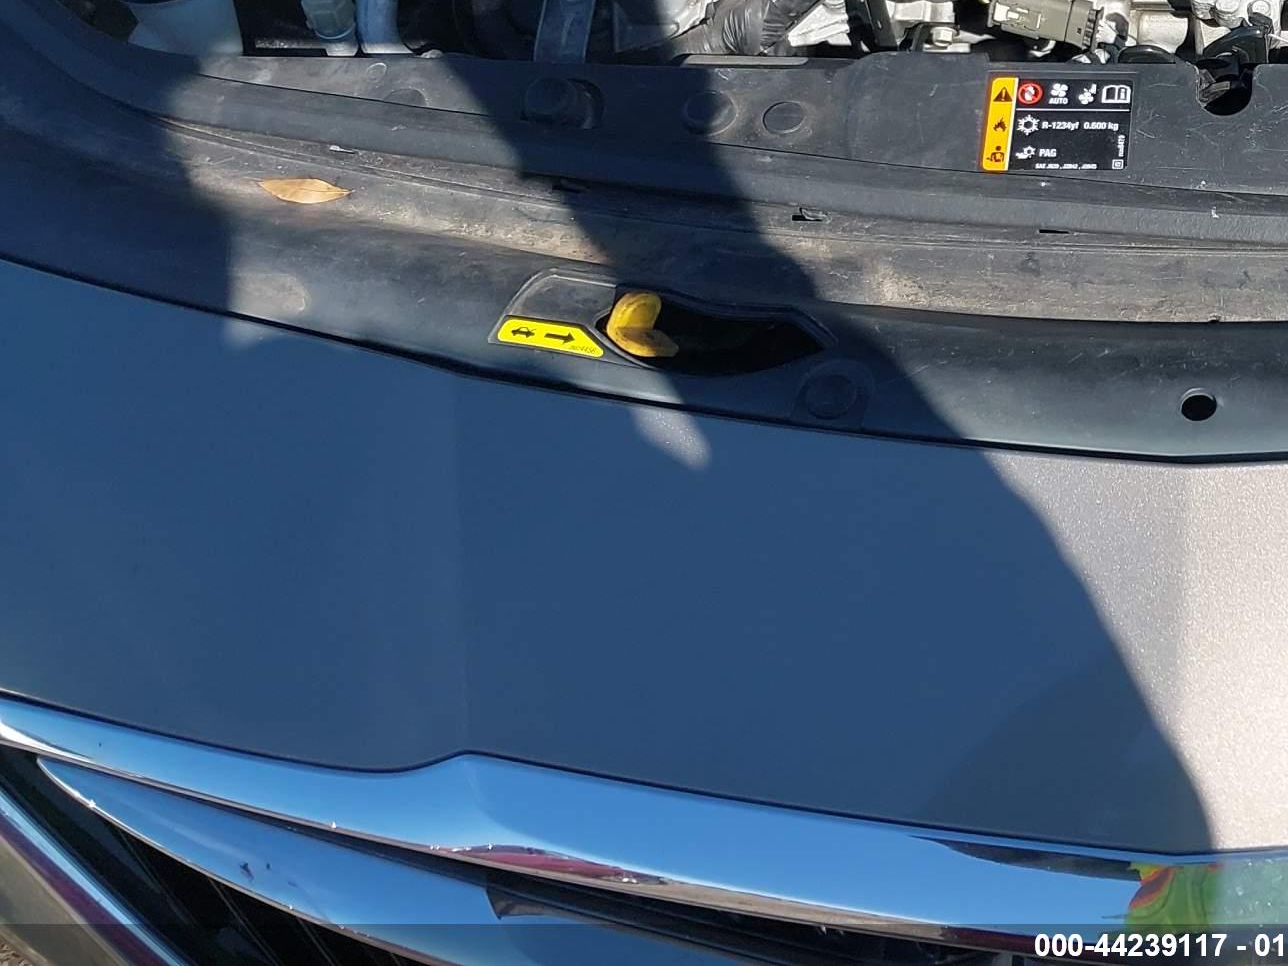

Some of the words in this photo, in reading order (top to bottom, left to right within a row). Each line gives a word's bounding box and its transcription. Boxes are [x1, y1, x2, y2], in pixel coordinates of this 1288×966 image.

[1048, 97, 1069, 105] AUTO
[1041, 121, 1080, 131] R-1234yf
[1107, 122, 1120, 132] kg
[1038, 148, 1057, 158] PAG
